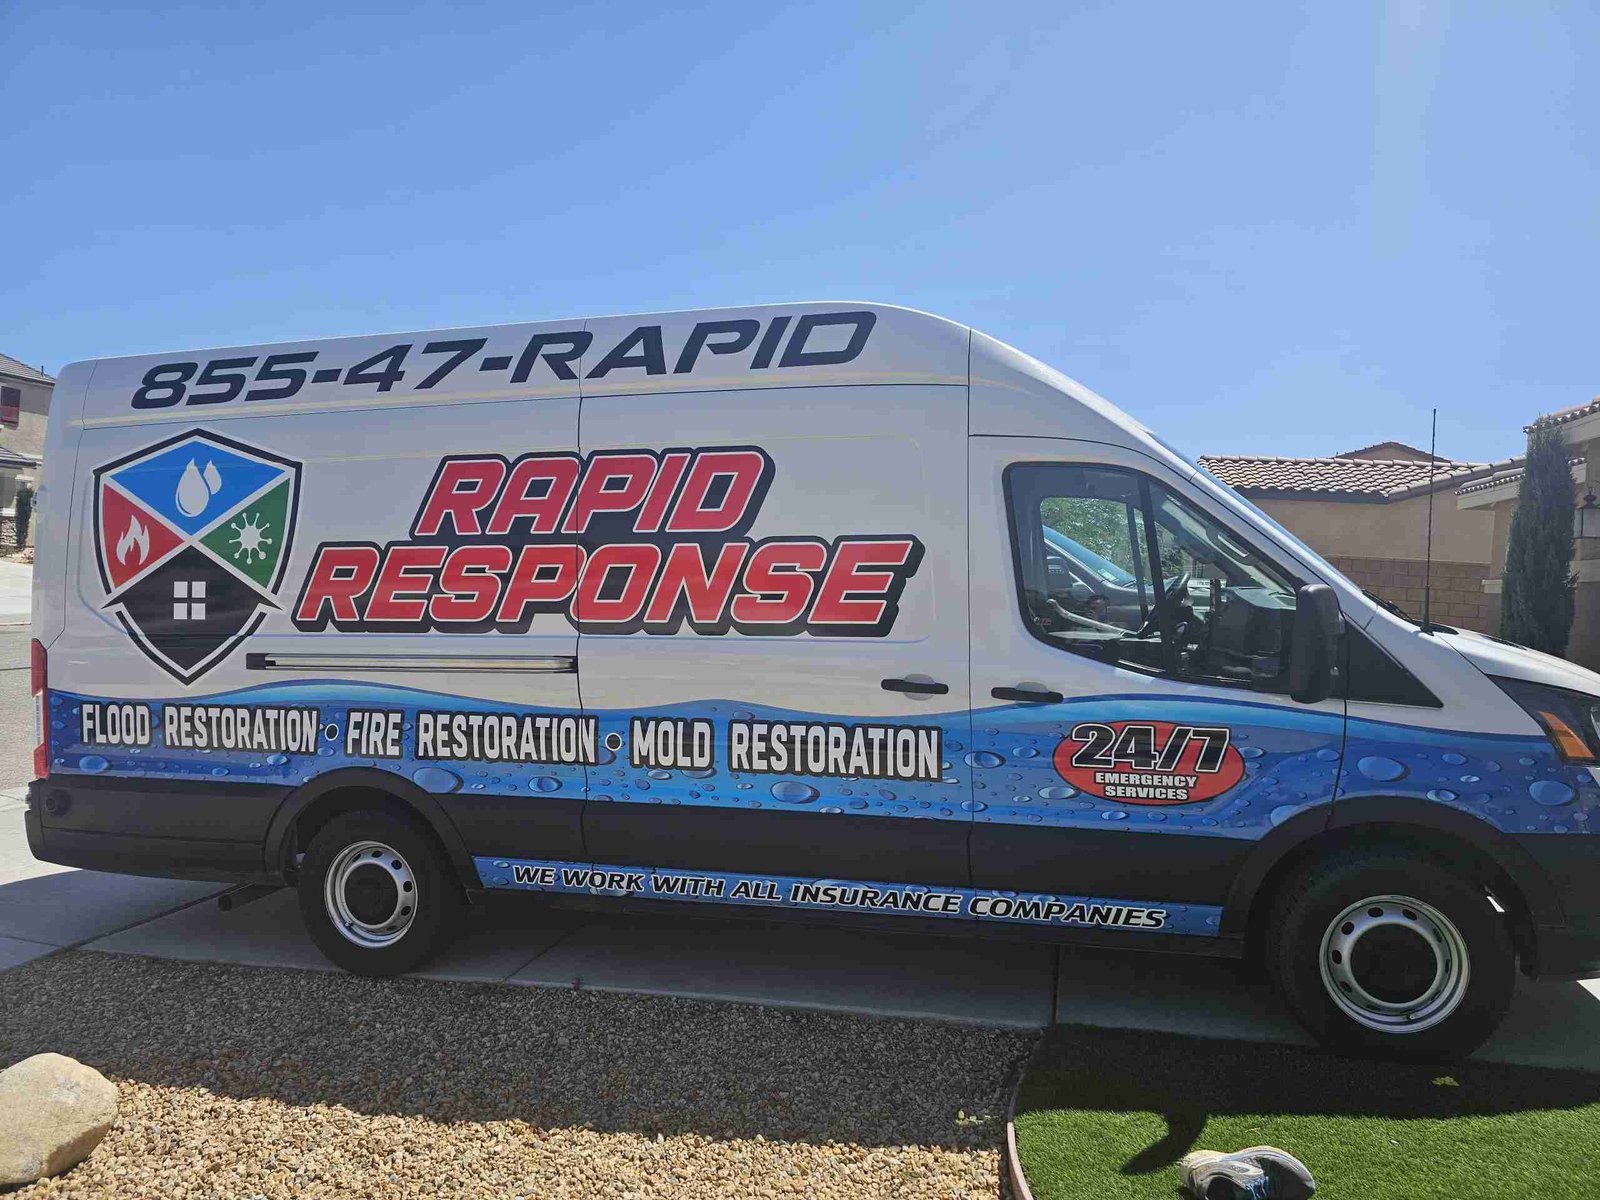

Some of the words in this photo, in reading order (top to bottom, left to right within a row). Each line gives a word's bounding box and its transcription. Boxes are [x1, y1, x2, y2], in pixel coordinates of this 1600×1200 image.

[131, 311, 877, 409] 855-47-RAPID
[412, 446, 772, 538] RAPID
[294, 536, 920, 632] RESPONSE
[80, 703, 151, 746] FLOOD
[164, 705, 318, 753] RESTORATION
[346, 711, 402, 757] FIRE
[417, 713, 596, 764] RESTORATION
[632, 719, 711, 769] MOLD
[731, 722, 939, 779] RESTORATION
[1071, 723, 1230, 773] 24/7
[1095, 772, 1197, 787] EMERGENCY
[1105, 785, 1188, 800] SERVICES
[513, 865, 555, 886] WE
[561, 868, 645, 892] WORK
[651, 874, 724, 897] WITH
[730, 880, 783, 901] ALL
[789, 884, 962, 914] INSURANCE
[968, 896, 1167, 929] COMPANIES
